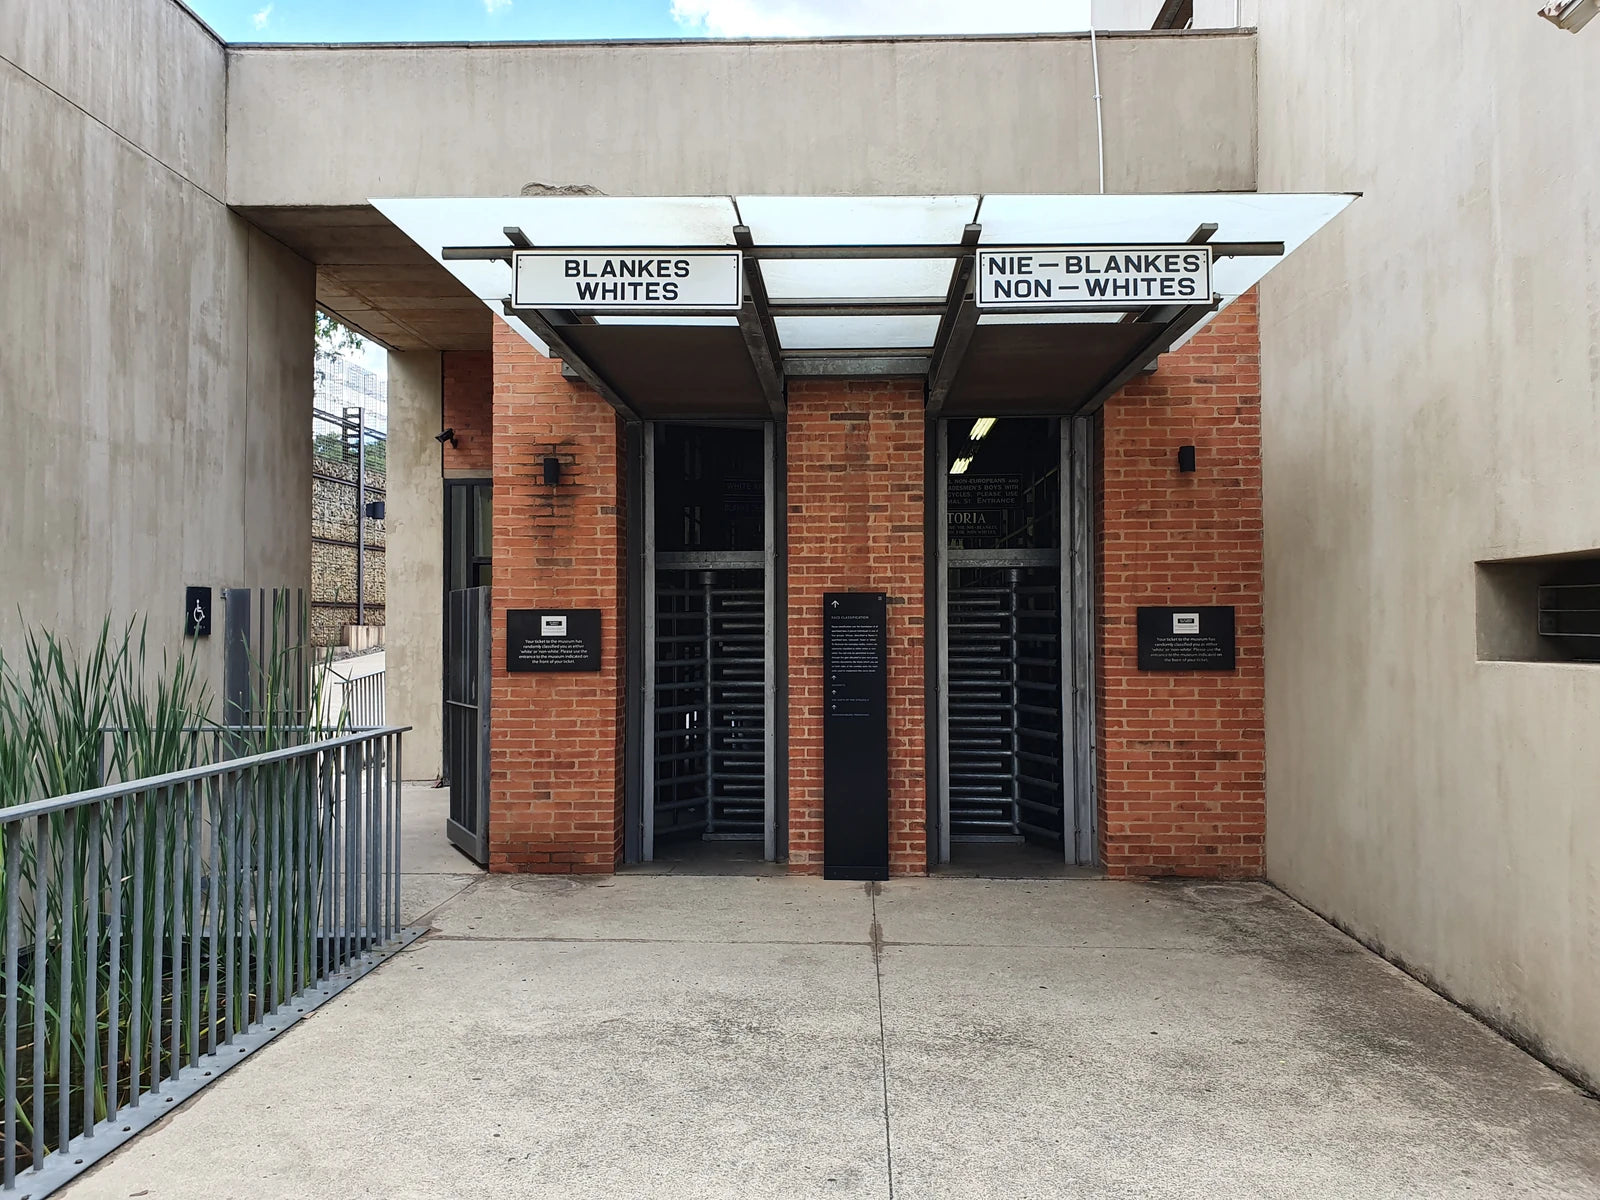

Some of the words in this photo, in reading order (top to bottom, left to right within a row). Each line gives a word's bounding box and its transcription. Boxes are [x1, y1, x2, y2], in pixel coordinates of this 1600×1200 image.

[564, 260, 690, 278] BLANKES
[576, 282, 679, 300] WHITES
[947, 512, 986, 524] TORIA
